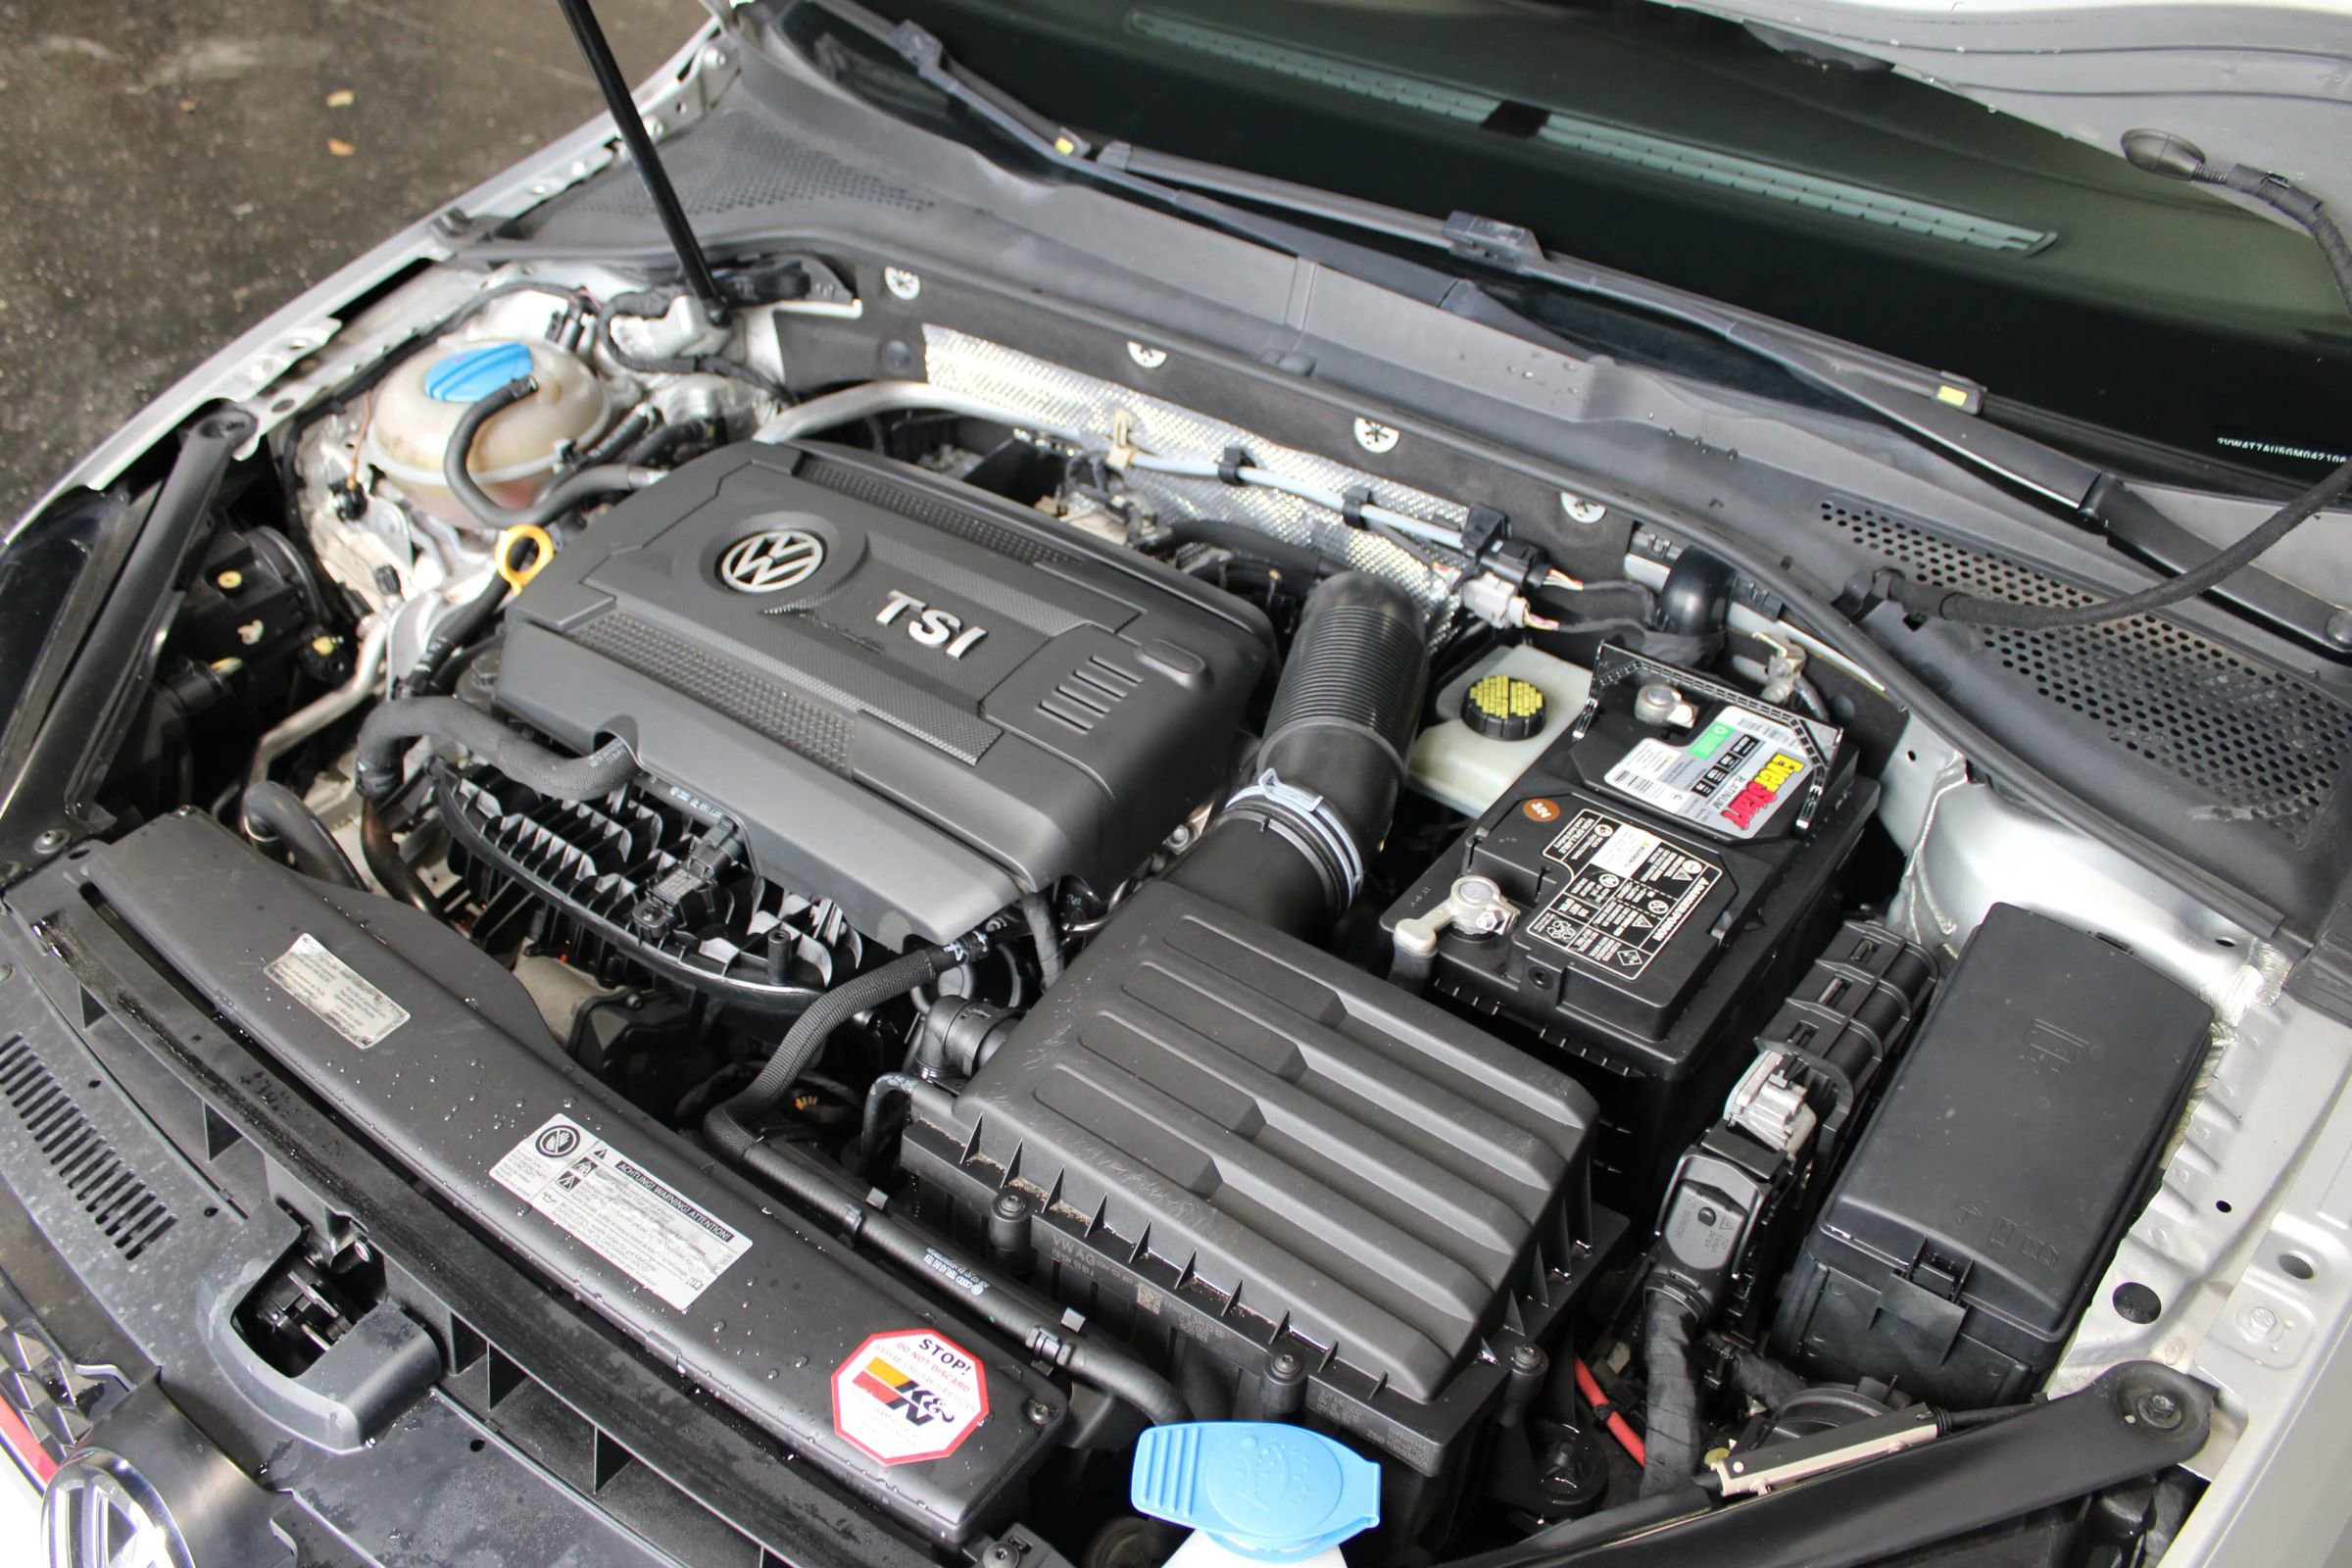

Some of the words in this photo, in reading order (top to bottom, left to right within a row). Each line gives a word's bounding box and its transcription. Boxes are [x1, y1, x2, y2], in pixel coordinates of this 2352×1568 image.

[875, 588, 989, 661] TSI
[1711, 775, 1746, 809] PLATINUM
[1719, 753, 1805, 831] EverStart
[616, 1161, 656, 1190] ACHTUNG!
[654, 1185, 692, 1214] WARNING!
[688, 1209, 731, 1241] ATTENTION!
[1053, 1232, 1075, 1253] VW
[1074, 1248, 1097, 1267] AG
[896, 1341, 910, 1353] DO
[909, 1349, 931, 1366] NOT
[929, 1362, 971, 1393] DISCARD
[918, 1338, 972, 1376] STOP!
